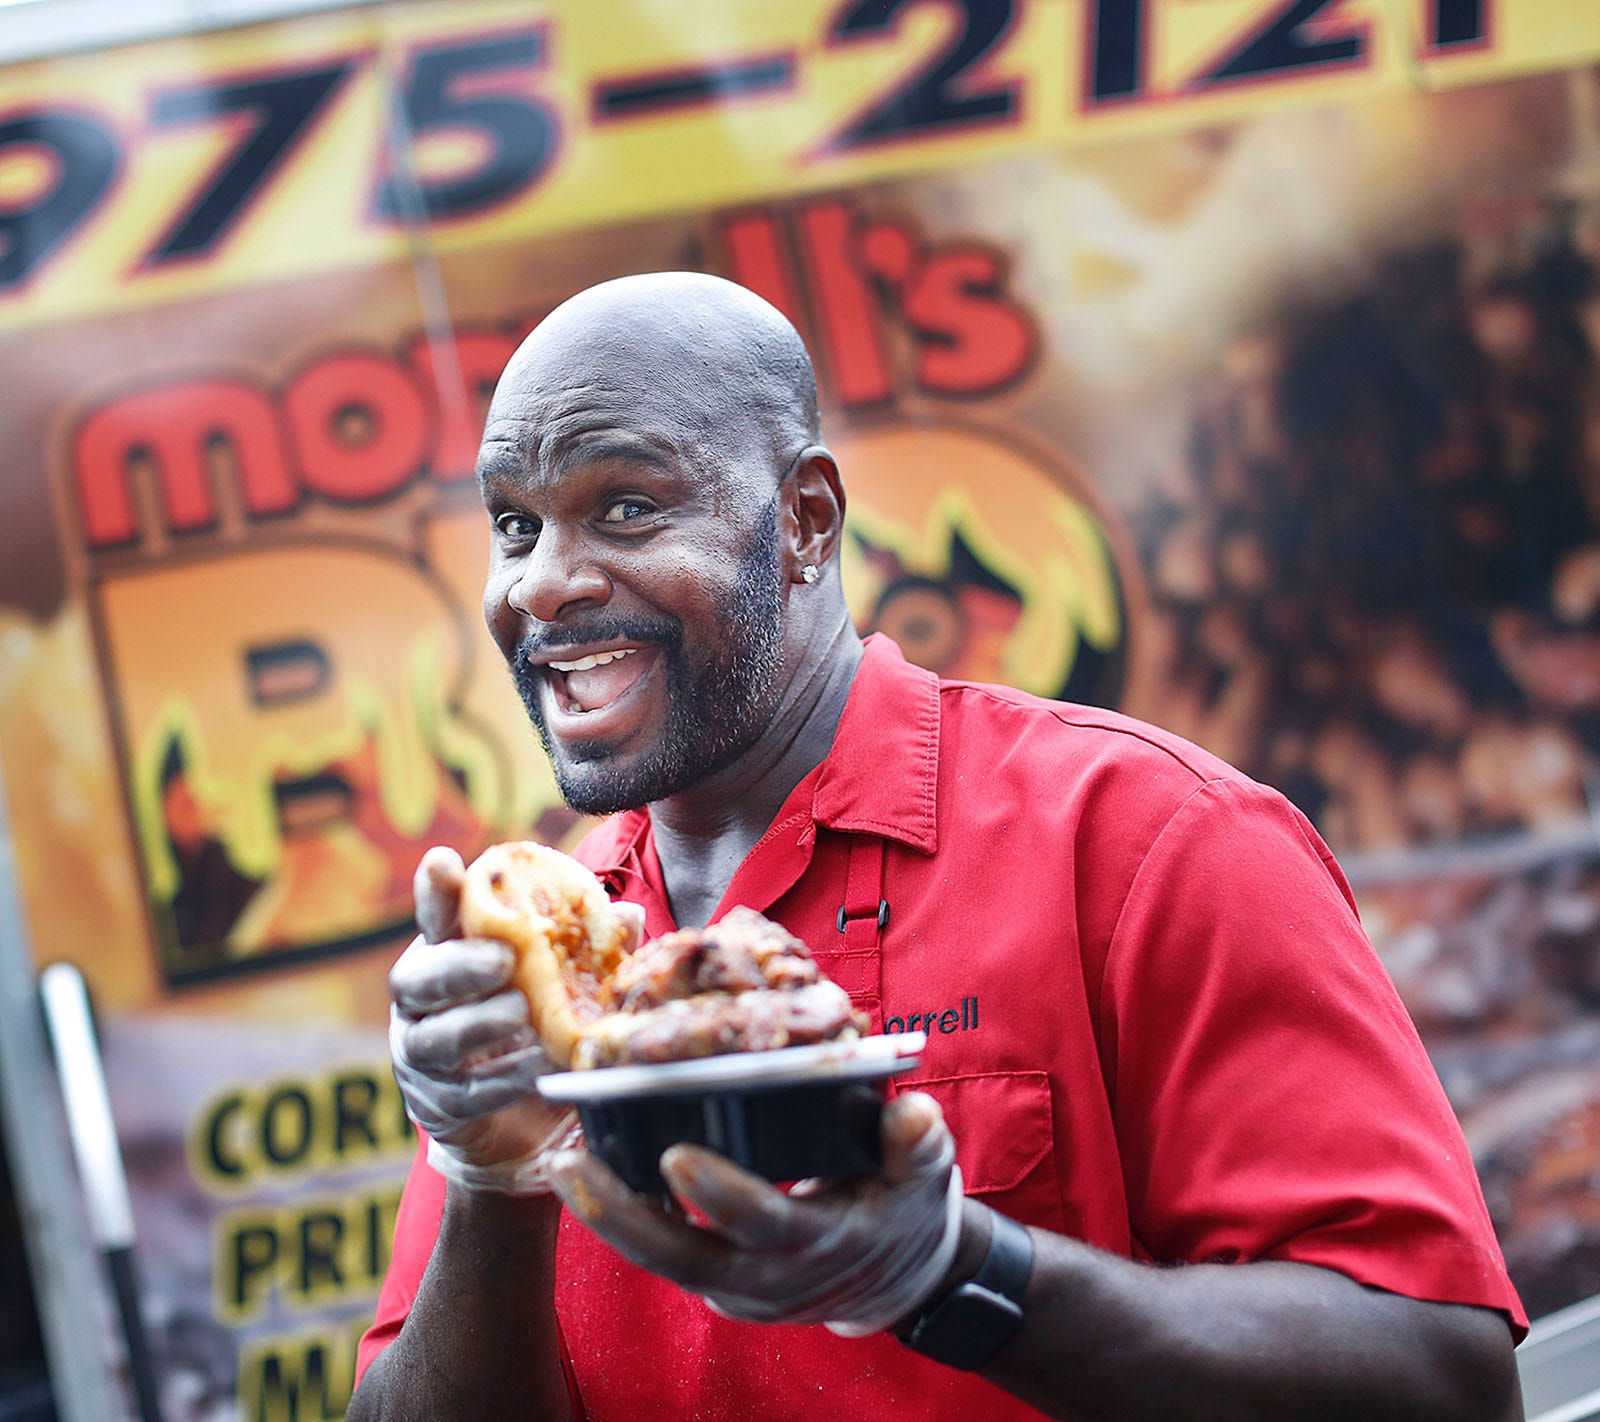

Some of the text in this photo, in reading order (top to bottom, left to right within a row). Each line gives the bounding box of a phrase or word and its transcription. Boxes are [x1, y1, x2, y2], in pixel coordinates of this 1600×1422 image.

[883, 996, 978, 1036] orrell
[209, 1075, 414, 1175] COR
[235, 1202, 379, 1307] PRI
